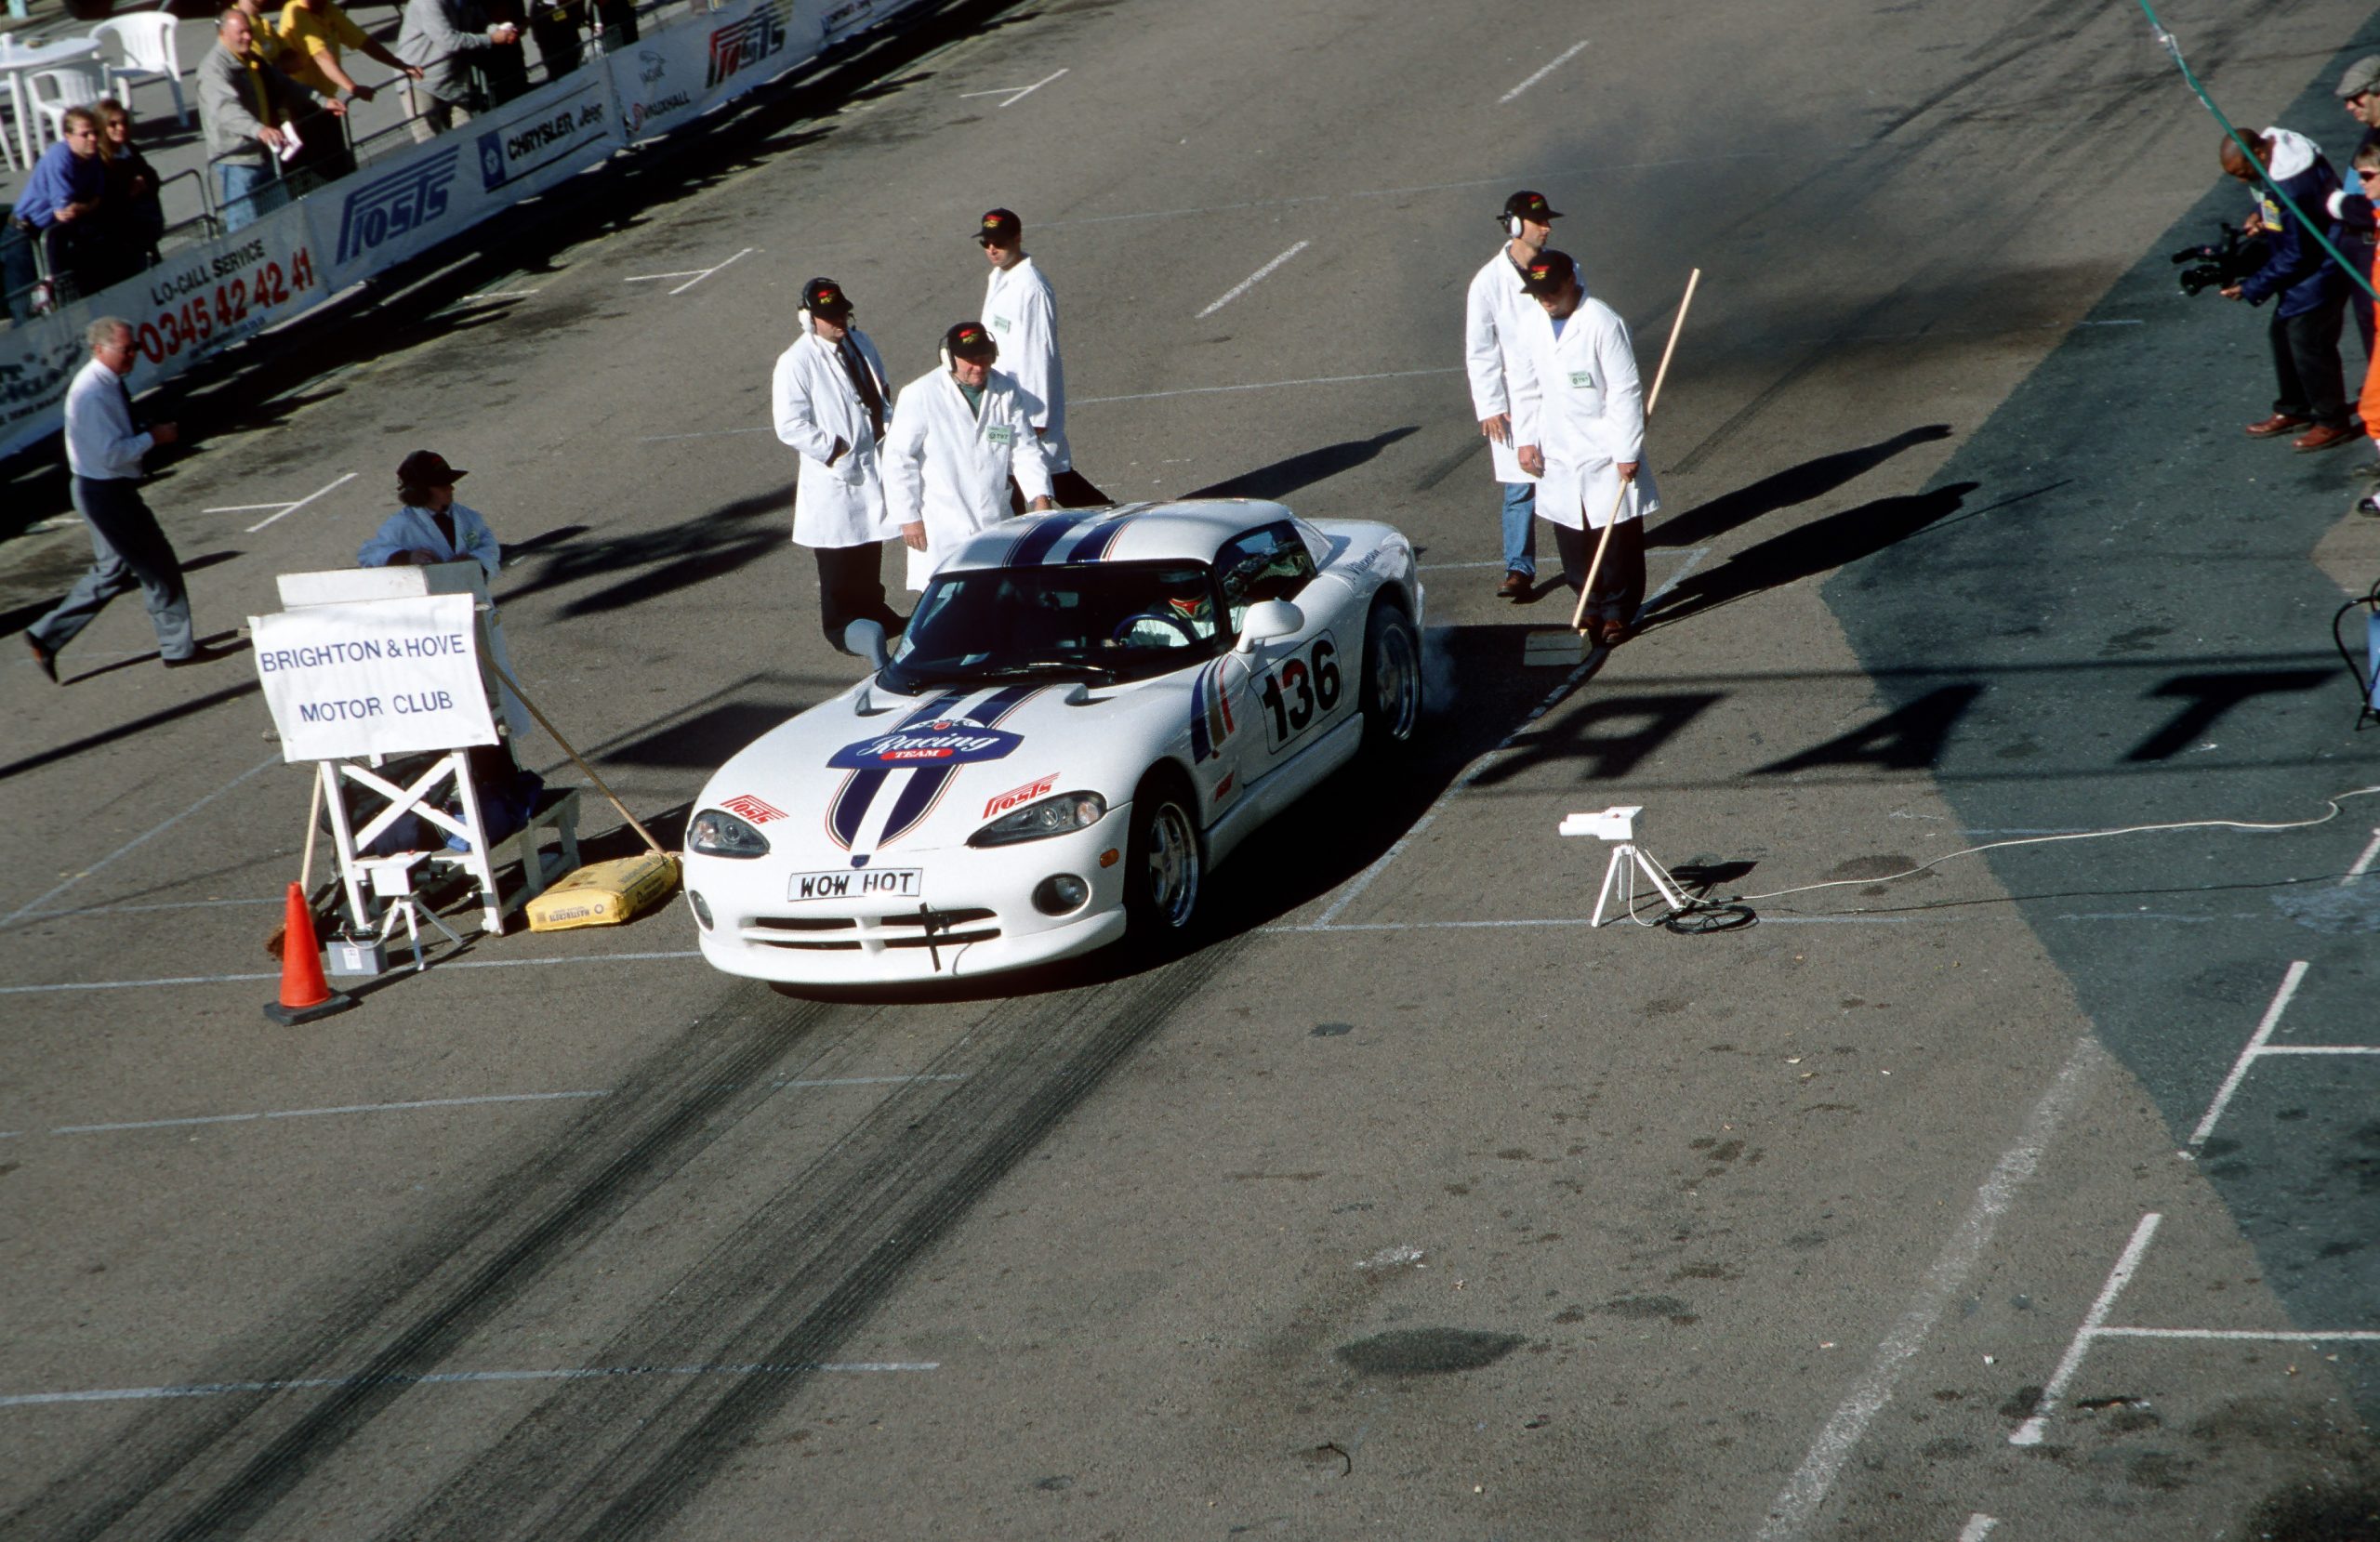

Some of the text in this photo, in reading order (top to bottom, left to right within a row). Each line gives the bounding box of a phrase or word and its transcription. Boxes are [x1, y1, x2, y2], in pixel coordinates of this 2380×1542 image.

[507, 101, 603, 161] CHRYSLER Jeep
[150, 239, 266, 306] LO-CALL SERVICE
[139, 296, 212, 364] 0345
[215, 280, 248, 326] 42
[253, 261, 289, 309] 42
[259, 634, 466, 673] BRIGHTON & HOVE
[299, 691, 454, 723] MOTOR CLUB
[1262, 639, 1341, 742] 136
[856, 732, 1000, 756] Racing
[894, 749, 940, 758] TEAM
[800, 872, 914, 897] WOW HOT
